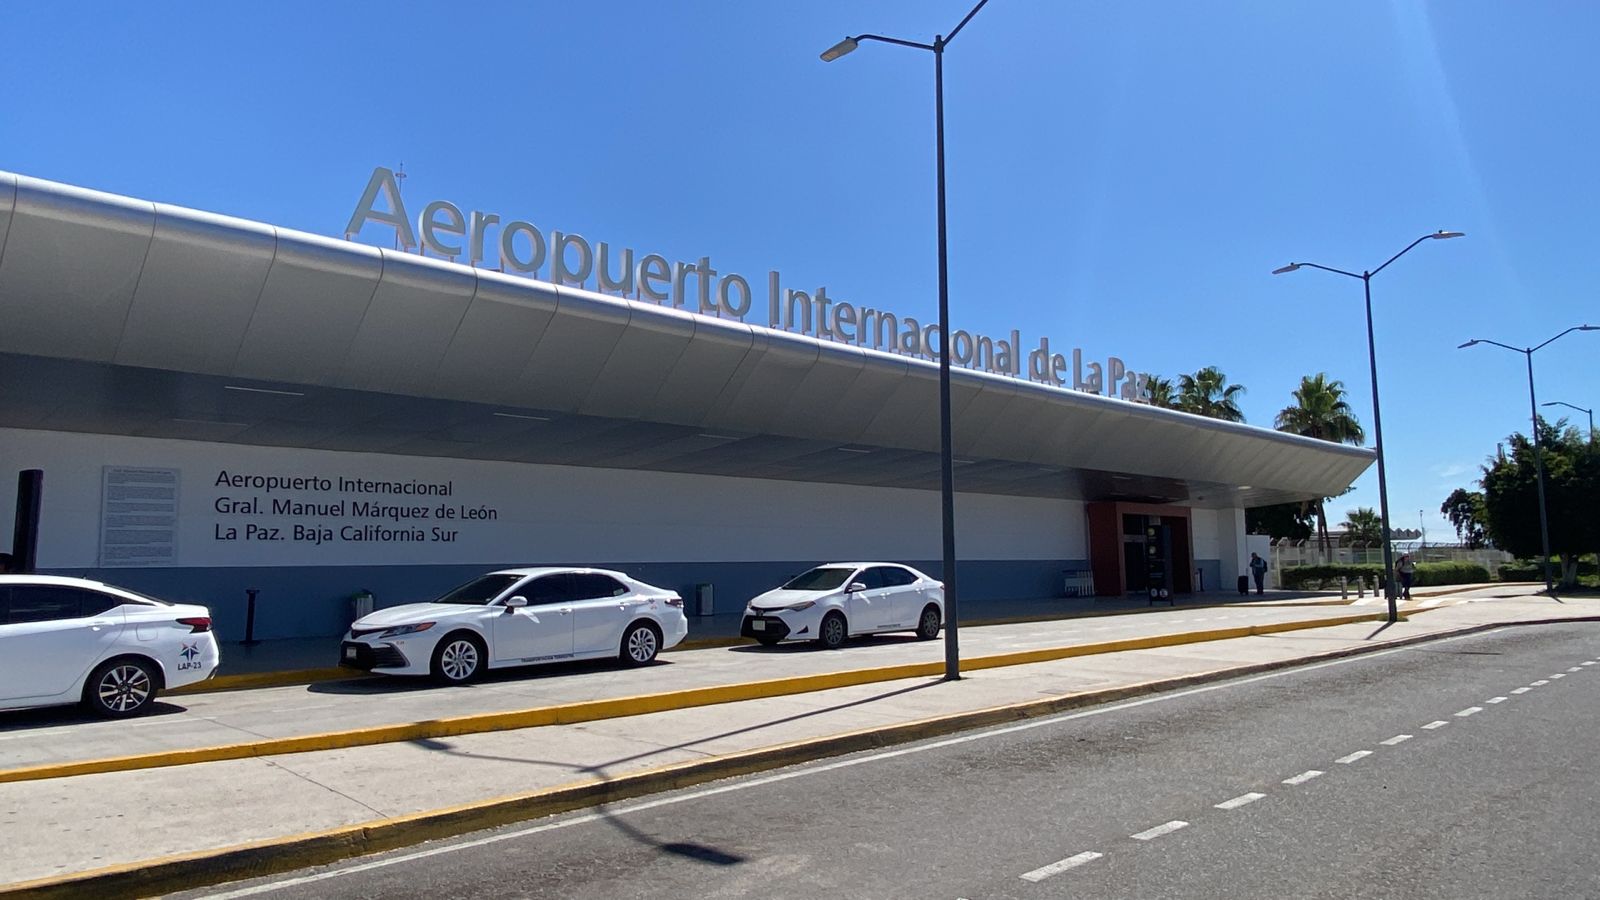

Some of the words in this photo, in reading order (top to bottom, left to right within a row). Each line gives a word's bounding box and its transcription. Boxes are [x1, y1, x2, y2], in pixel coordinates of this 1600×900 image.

[345, 166, 752, 317] Aeropuerto
[768, 270, 1021, 376] Internaconal
[1028, 337, 1067, 385] de
[1073, 348, 1103, 393] La
[1108, 357, 1150, 401] Paz
[214, 470, 332, 493] Aeropuerto
[339, 476, 453, 496] Internacional
[214, 496, 264, 514] Gral.
[272, 498, 345, 516] Manuel
[352, 501, 430, 522] Márquez
[435, 504, 455, 519] de
[461, 505, 498, 520] León
[215, 523, 237, 540] La
[246, 523, 285, 541] Paz.
[294, 524, 333, 545] Baja
[340, 525, 425, 542] California
[431, 527, 459, 542] Sur
